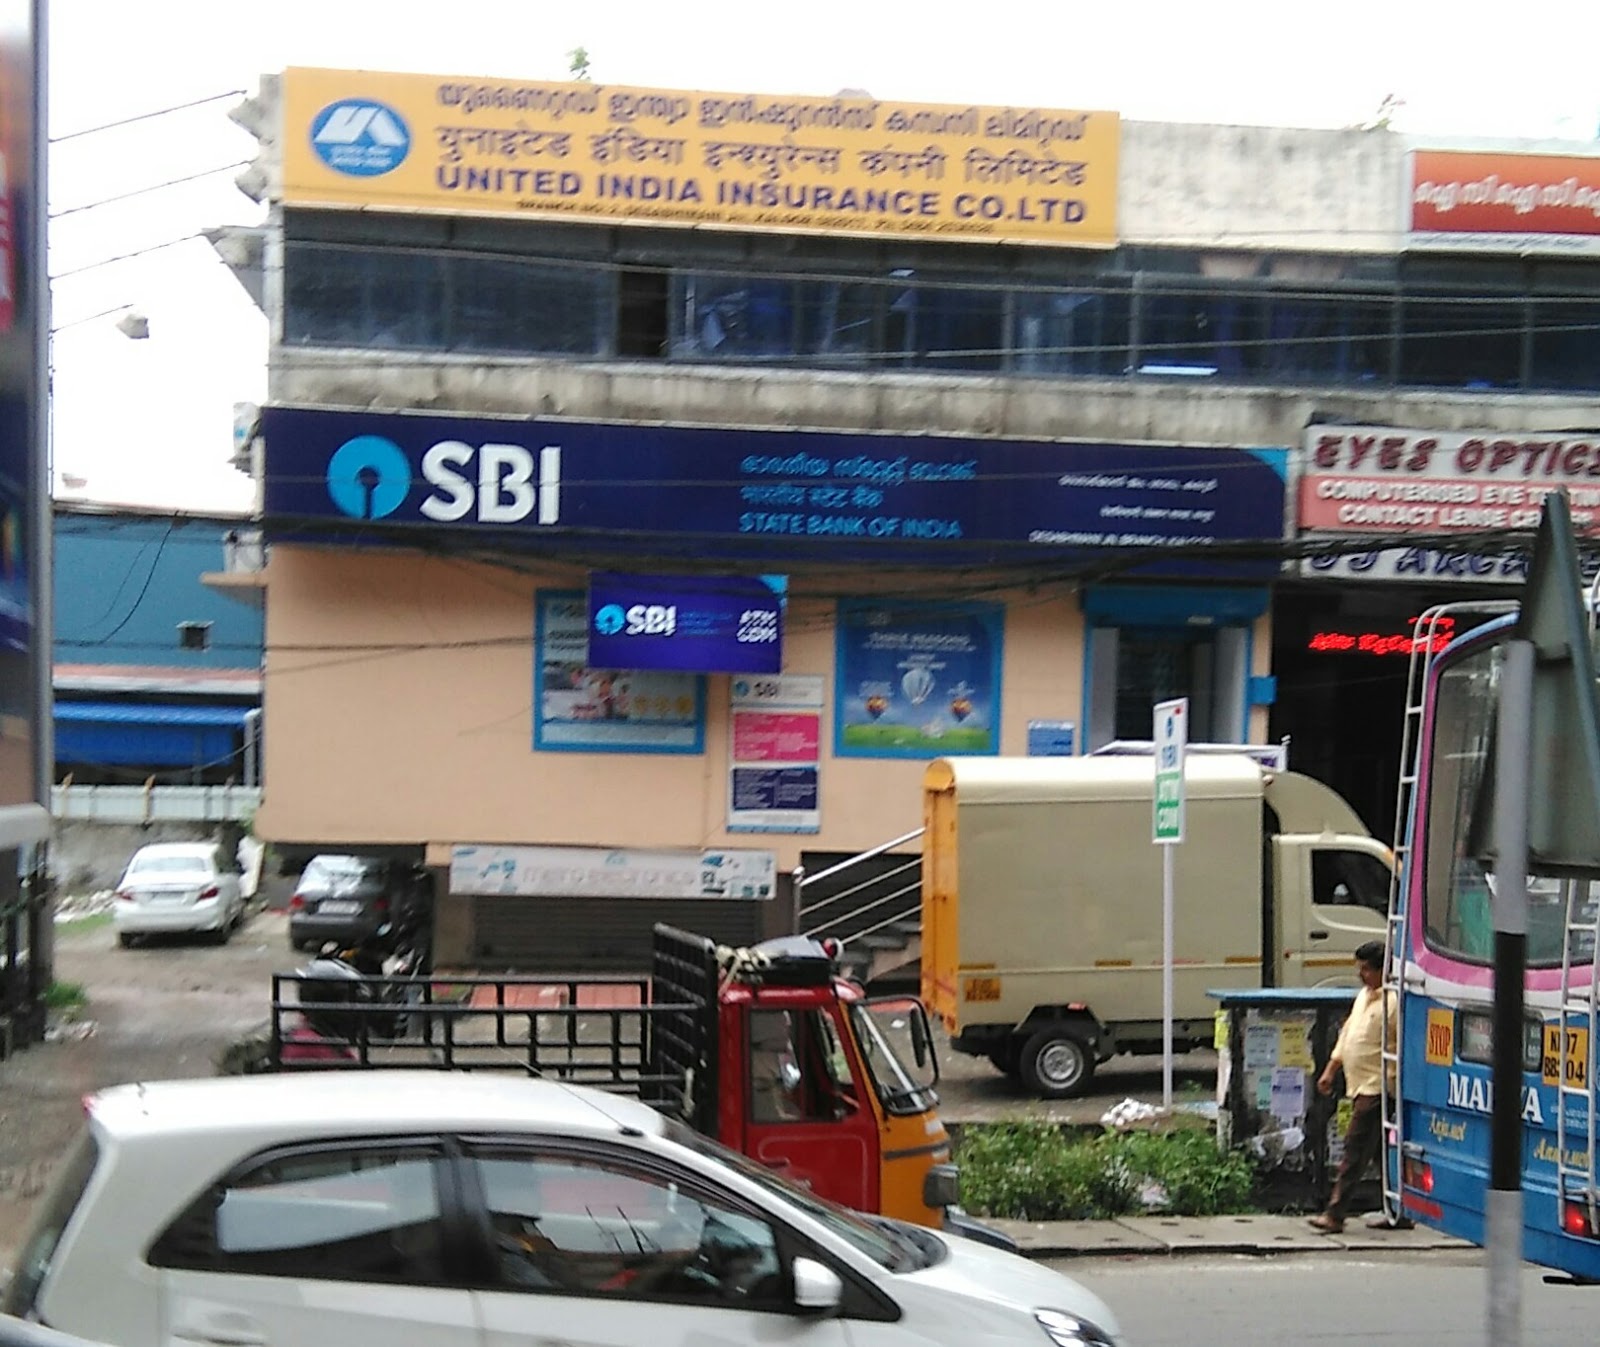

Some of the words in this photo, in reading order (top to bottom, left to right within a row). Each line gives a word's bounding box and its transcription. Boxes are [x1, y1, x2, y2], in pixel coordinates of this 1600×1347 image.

[436, 164, 582, 196] UNITED
[598, 173, 702, 203] INDIA
[717, 178, 941, 216] INSURANCE
[954, 192, 1087, 224] CO.LTD
[1314, 433, 1440, 472] EYES
[419, 440, 562, 525] SBI
[1481, 485, 1525, 505] EYE
[739, 511, 805, 535] STATE
[807, 514, 866, 538] BANK
[867, 516, 902, 538] OF
[902, 517, 965, 540] INDIA
[1338, 503, 1437, 527] CONTACT
[1438, 507, 1507, 528] LENSE
[625, 604, 677, 636] SBI
[1428, 1022, 1452, 1057] STOP
